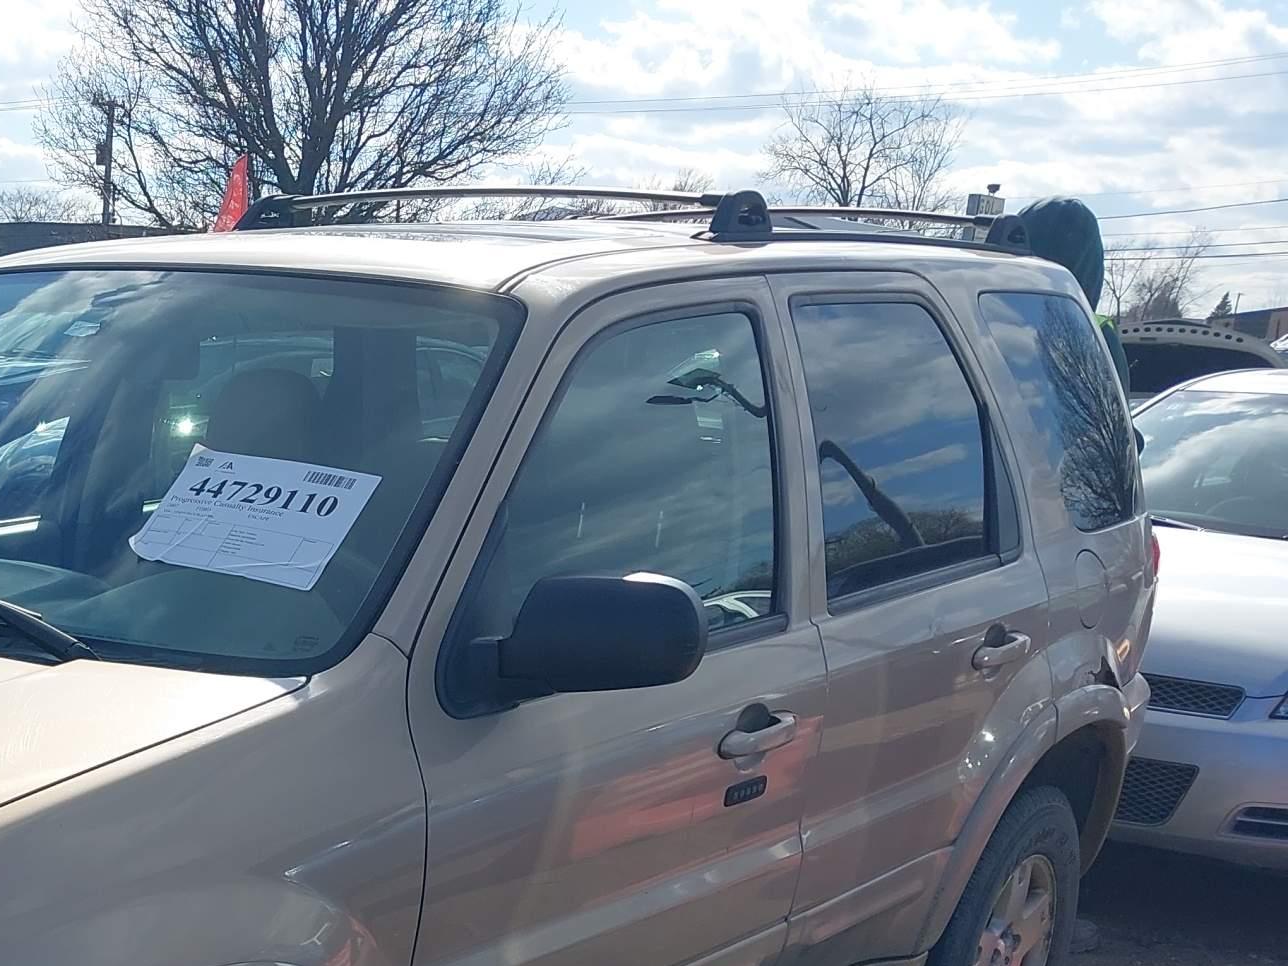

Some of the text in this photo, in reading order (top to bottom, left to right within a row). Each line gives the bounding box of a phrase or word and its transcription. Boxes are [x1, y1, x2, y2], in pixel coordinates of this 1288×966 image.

[171, 494, 213, 506] Progressive
[214, 500, 245, 512] Casualty
[247, 504, 285, 518] Insurance
[189, 477, 339, 517] 44729110
